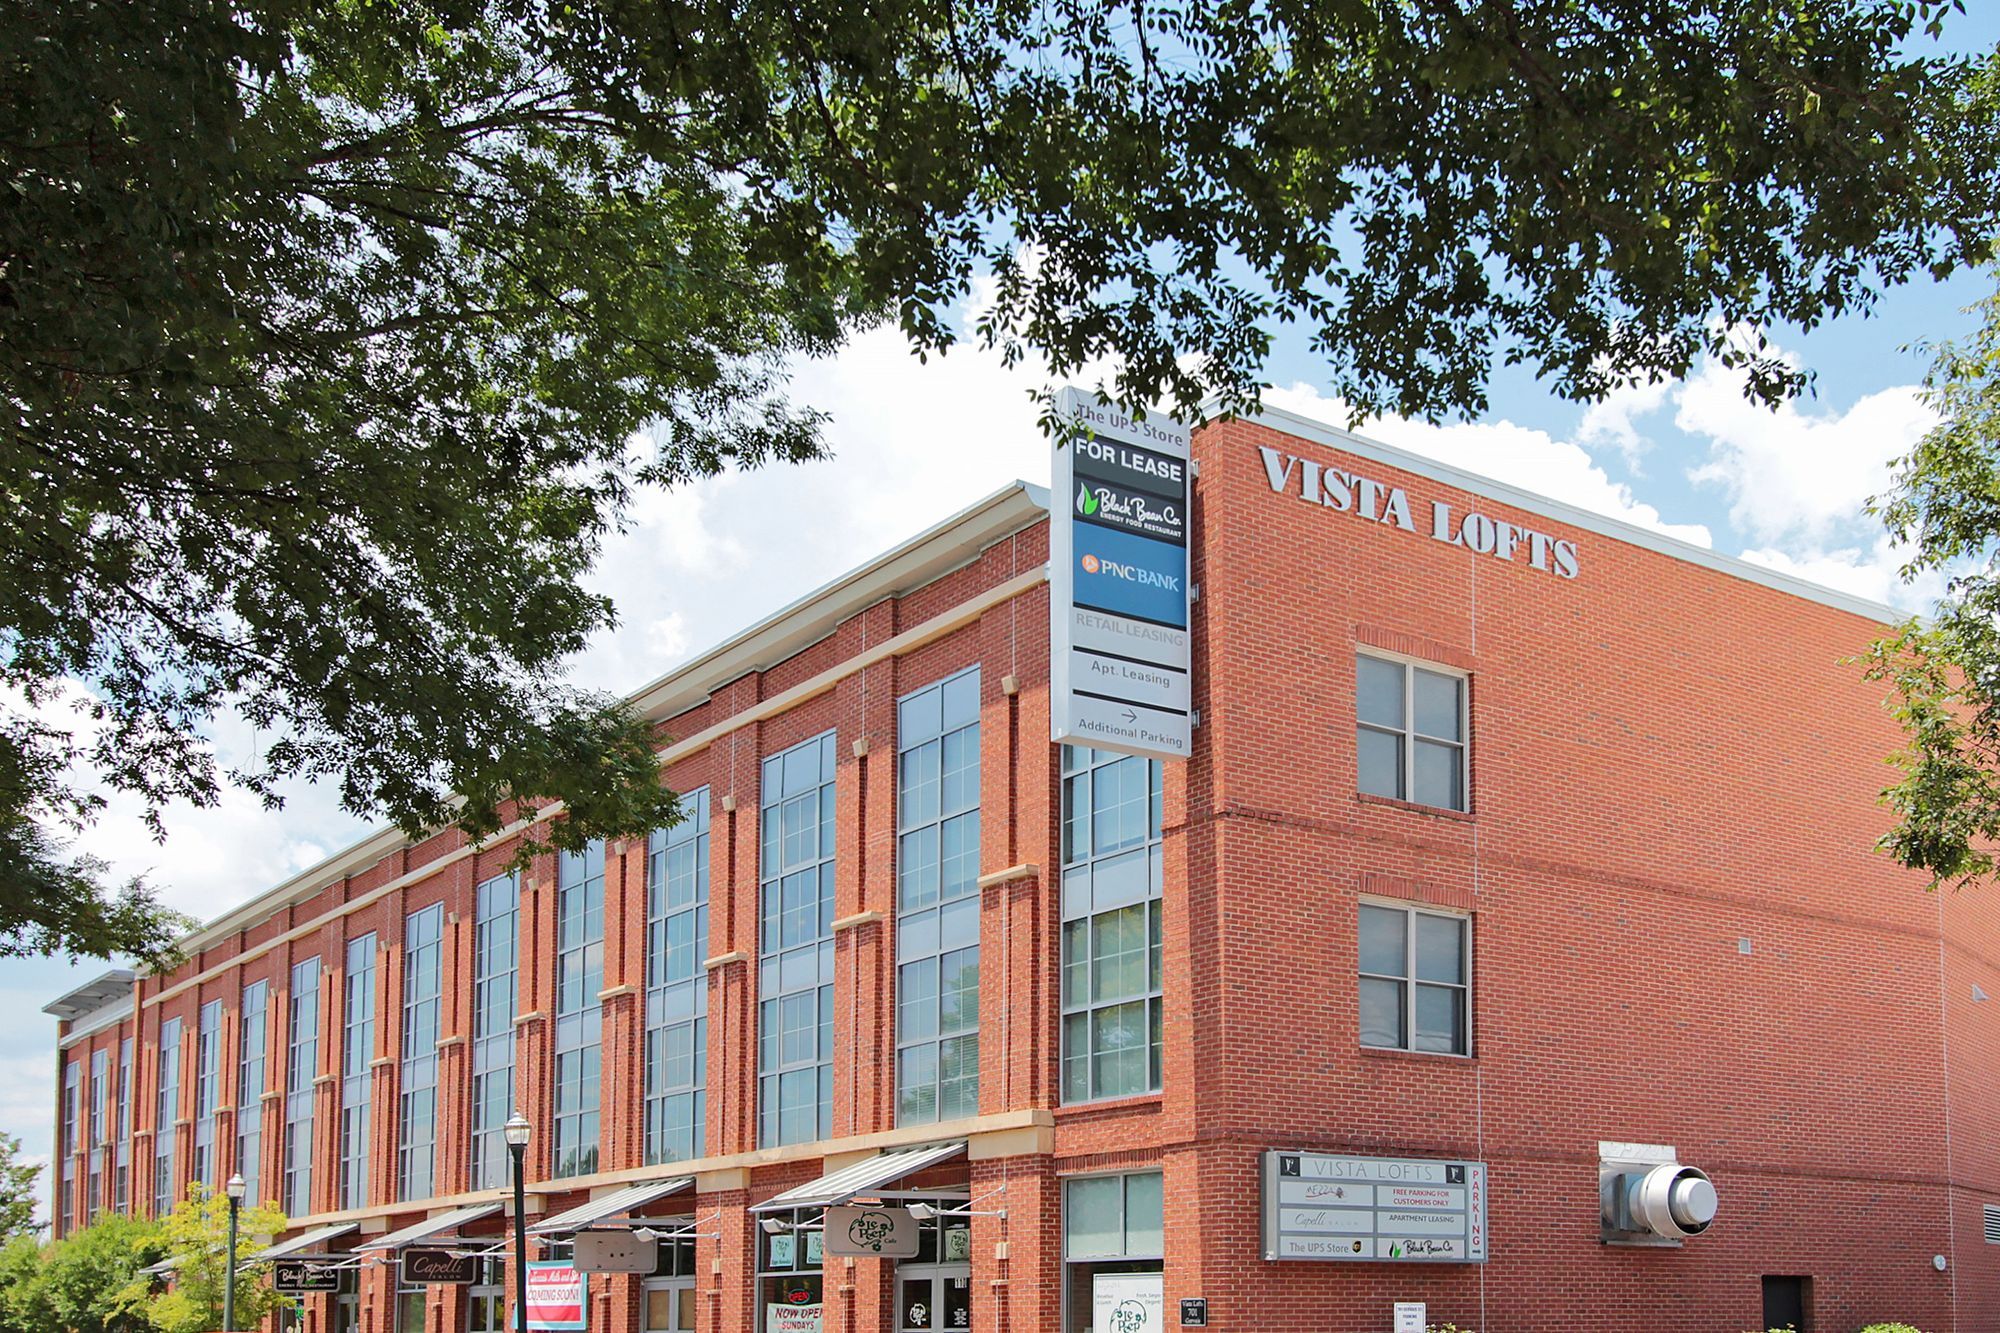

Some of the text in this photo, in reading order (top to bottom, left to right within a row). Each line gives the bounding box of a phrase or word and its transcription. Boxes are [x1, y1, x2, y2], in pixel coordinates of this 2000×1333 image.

[1077, 403, 1183, 446] The UPS Store
[1076, 437, 1182, 483] FOR LEASE
[1095, 488, 1131, 516] Black
[1130, 497, 1163, 522] Bean
[1258, 446, 1579, 579] VISTA LOFTS
[1100, 511, 1182, 538] ENERGY FOOD RESTAURANT
[1076, 613, 1184, 647] RETAIL LEASING
[1091, 660, 1170, 689] Apt. Leasing
[1079, 718, 1183, 749] Additional Parking
[1314, 1160, 1367, 1178] VISTA
[1378, 1163, 1432, 1181] LOFTS
[1393, 1198, 1432, 1206] CUSTOMERS
[1409, 1189, 1436, 1197] PARKING
[1389, 1214, 1427, 1222] APARTMENT
[1472, 1170, 1480, 1246] PARKING
[859, 1229, 886, 1240] Peep
[1290, 1242, 1349, 1253] The UPS Store
[1403, 1239, 1424, 1254] Black
[1424, 1239, 1443, 1254] Bean
[414, 1256, 464, 1279] Capelli
[775, 1307, 799, 1319] NOW
[782, 1320, 815, 1330] SUNDAYS
